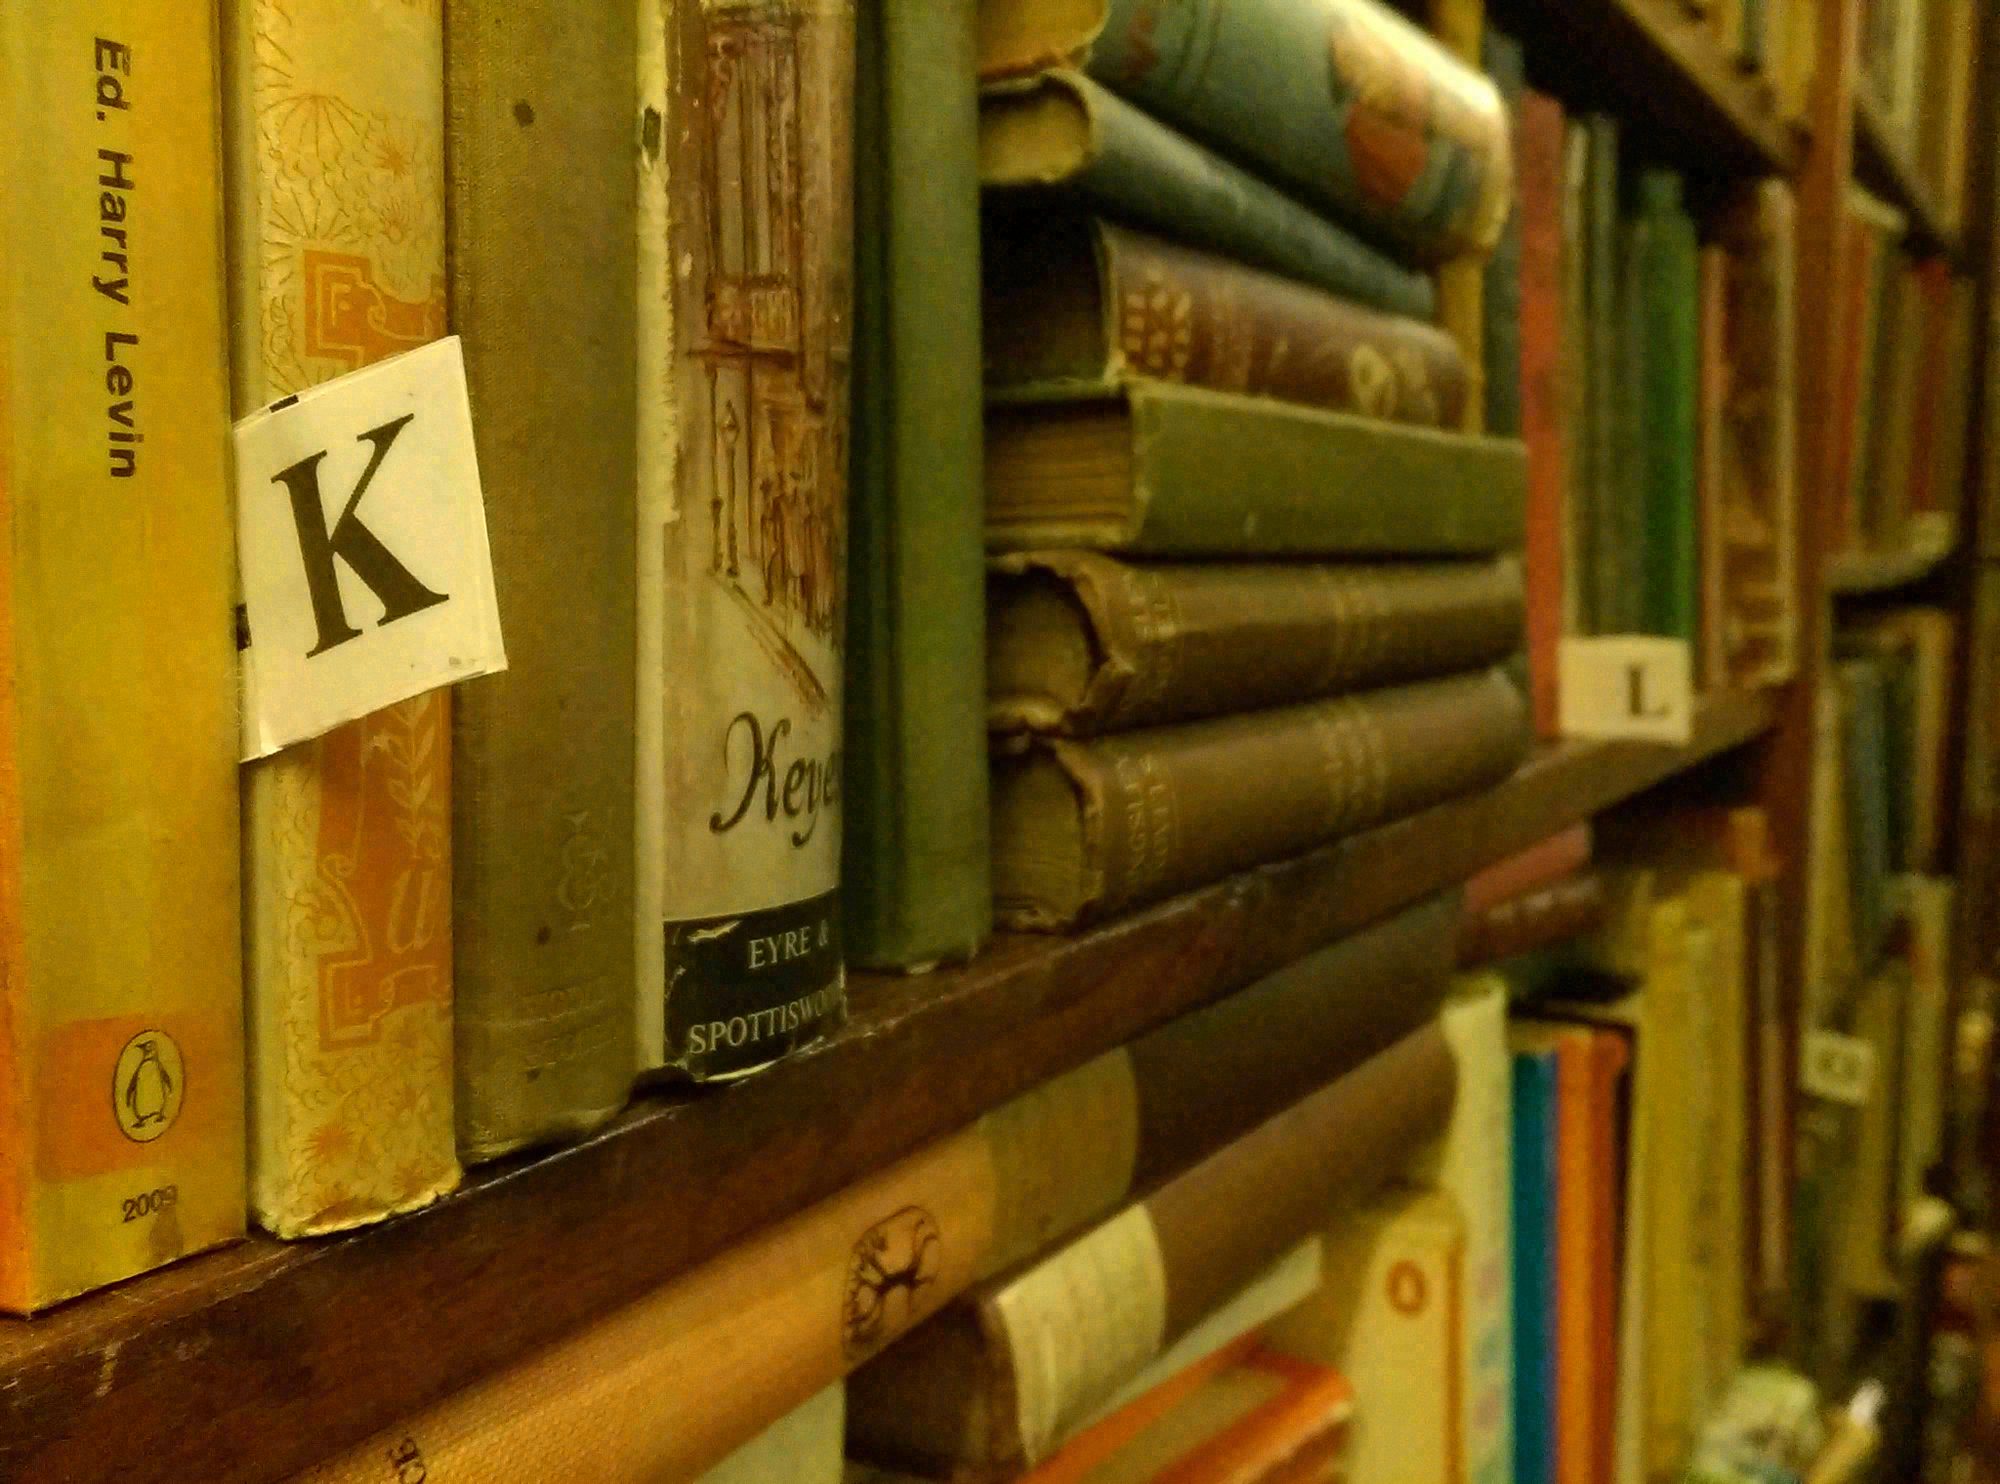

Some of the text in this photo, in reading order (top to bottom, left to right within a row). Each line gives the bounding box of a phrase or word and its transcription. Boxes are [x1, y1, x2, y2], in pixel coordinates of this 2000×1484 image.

[91, 36, 145, 478] Ed. Harry Levin
[270, 412, 450, 660] K
[1626, 663, 1671, 720] L
[748, 925, 812, 970] EYRE
